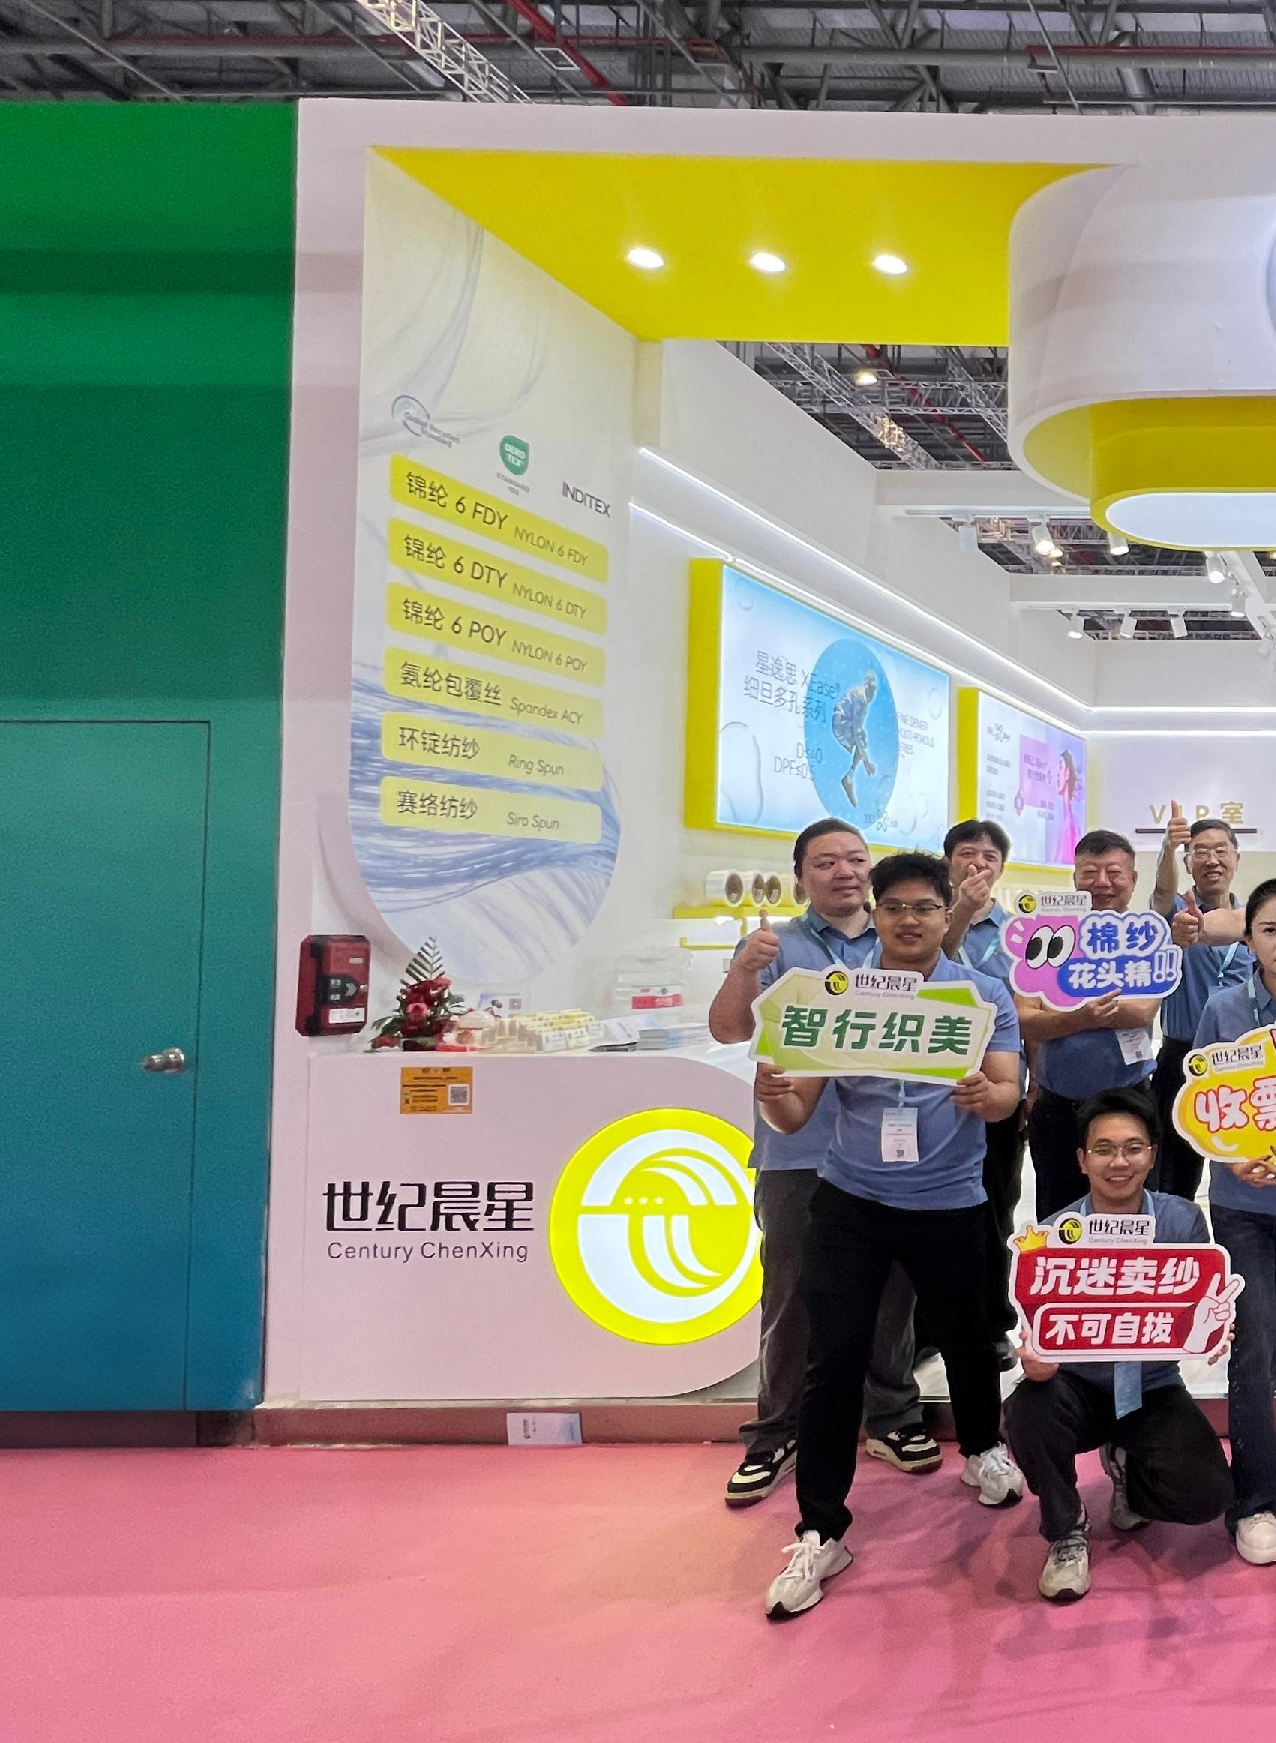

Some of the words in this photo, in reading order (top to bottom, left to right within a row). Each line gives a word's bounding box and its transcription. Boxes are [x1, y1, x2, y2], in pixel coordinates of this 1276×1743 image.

[406, 471, 448, 508] 锦纶
[456, 496, 465, 514] 6
[472, 502, 508, 530] FDY
[514, 526, 555, 554] NYLON
[558, 544, 565, 557] 6
[567, 549, 588, 566] FDY
[562, 482, 611, 517] INDITEX
[404, 534, 446, 569] 锦纶
[454, 556, 464, 574] 6
[471, 559, 508, 588] DTY
[512, 583, 553, 608] NYLON
[556, 598, 563, 611] 6
[566, 602, 587, 619] DTY
[402, 598, 445, 631] 锦纶
[451, 616, 462, 634] 6
[469, 621, 507, 647] POY
[512, 640, 553, 664] NYLON
[556, 654, 563, 666] 6
[566, 657, 588, 673] POY
[401, 661, 502, 707] 氨纶包覆丝
[511, 697, 558, 721] Spandex
[562, 709, 583, 725] ACY
[398, 726, 480, 760] 环锭纺纱
[508, 754, 534, 774] Ring
[537, 760, 564, 776] Spun
[397, 790, 478, 820] 赛络纺纱
[507, 812, 529, 827] Siro
[532, 814, 560, 831] Spun
[1087, 921, 1159, 953] 棉纱
[855, 974, 917, 992] 世纪晨星
[781, 1005, 973, 1056] 智行织美
[1212, 1045, 1262, 1066] 世纪晨星
[322, 1180, 534, 1232] 世纪晨星
[1089, 1220, 1150, 1236] 世纪晨星
[327, 1242, 413, 1263] Century
[420, 1242, 529, 1263] ChenXing
[1029, 1256, 1200, 1296] 沉迷卖纱
[1045, 1312, 1175, 1345] 不可自拔
